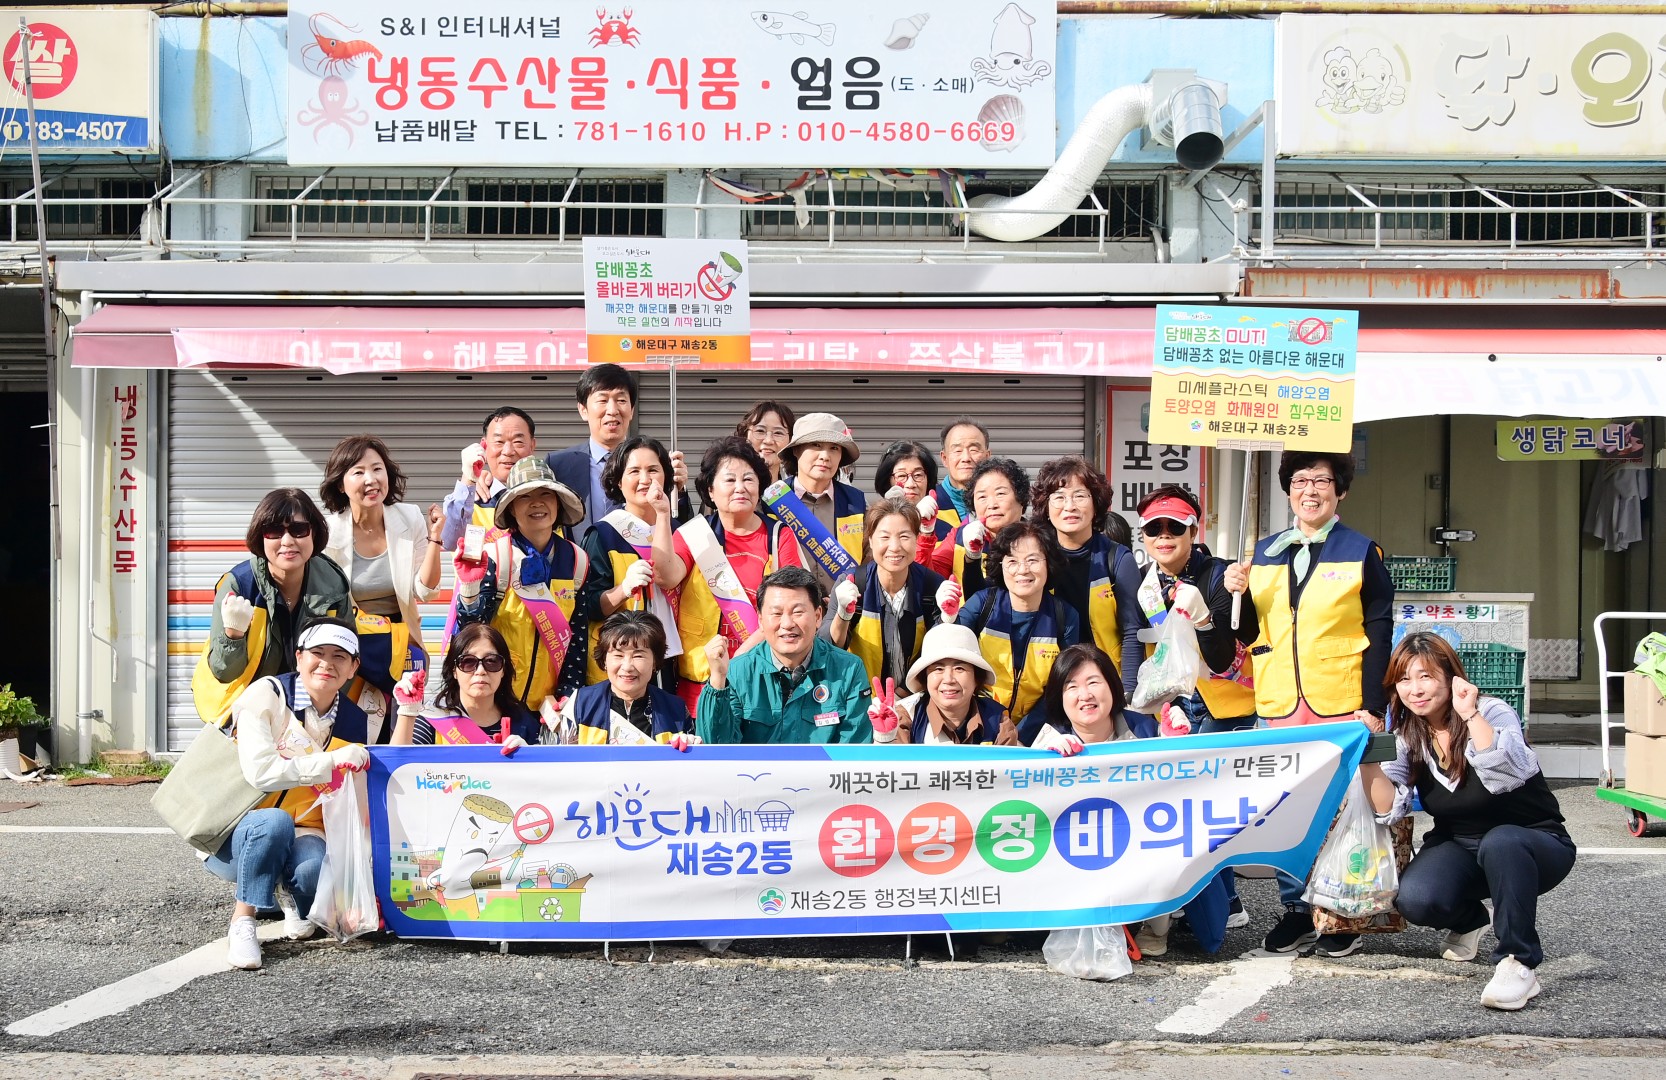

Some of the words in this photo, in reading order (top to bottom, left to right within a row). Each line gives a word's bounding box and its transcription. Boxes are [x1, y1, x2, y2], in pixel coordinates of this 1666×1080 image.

[380, 17, 425, 36] S&I
[437, 16, 561, 39] 인터내셔널
[10, 37, 71, 84] 쌀
[790, 56, 884, 111] 얼음
[374, 119, 478, 143] 납품배달
[574, 121, 706, 142] 781-1610
[797, 121, 1015, 142] 010-4580-6669
[595, 261, 653, 279] 담배꽁초
[596, 281, 653, 299] 올바르게
[657, 282, 697, 300] 버리기
[605, 303, 635, 314] 깨끗한
[638, 303, 677, 315] 해운대를
[681, 304, 710, 315] 만들기
[714, 304, 733, 315] 위한
[617, 316, 637, 328] 작은
[641, 316, 670, 328] 실천의
[674, 317, 722, 328] 시작입니다
[636, 339, 678, 350] 해운대구
[681, 339, 718, 351] 재송2동
[1165, 327, 1221, 343] 담배꽁초
[1226, 329, 1266, 345] OUT!
[1163, 347, 1215, 363] 담배꽁초
[1219, 349, 1245, 365] 없는
[1249, 350, 1301, 367] 아름다운
[1305, 351, 1345, 368] 해운대
[1178, 380, 1269, 397] 미세플라스틱
[1277, 385, 1330, 400] 해양오염
[1164, 398, 1216, 416] 토양오염
[1227, 400, 1279, 419] 화재원인
[1290, 403, 1342, 421] 침수원인
[1208, 421, 1259, 434] 해운대구
[1263, 422, 1309, 436] 재송2동
[1511, 425, 1626, 455] 생닭코너
[1123, 440, 1192, 472] 포장
[805, 537, 841, 575] 담배꽁초
[415, 775, 492, 794] Haeundae
[828, 770, 922, 795] 깨끗하고
[928, 769, 998, 791] 쾌적한
[1233, 752, 1300, 779] 만들기
[666, 840, 793, 876] 재송2동
[790, 888, 868, 911] 재송2동
[874, 885, 1001, 909] 행정복지센터
